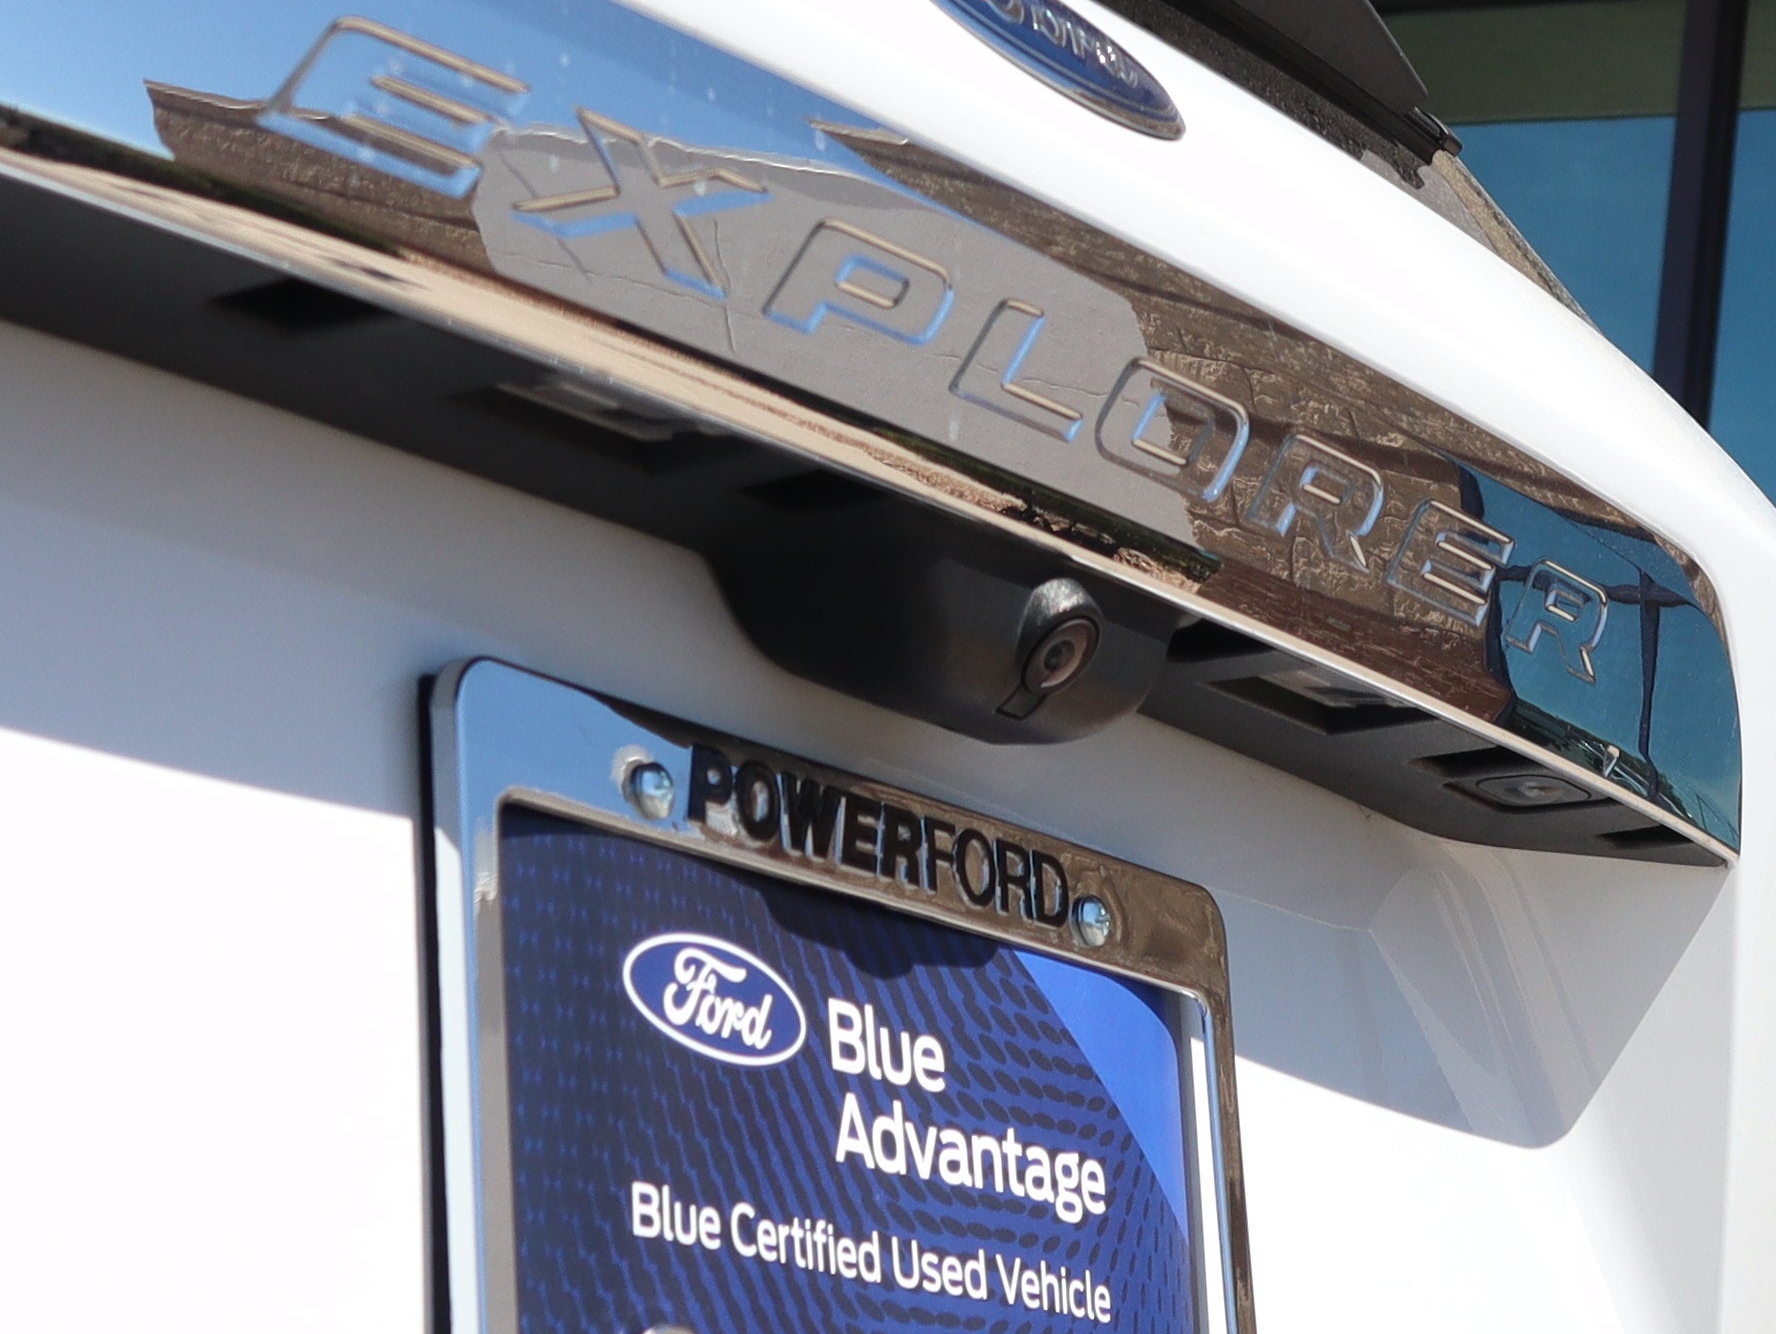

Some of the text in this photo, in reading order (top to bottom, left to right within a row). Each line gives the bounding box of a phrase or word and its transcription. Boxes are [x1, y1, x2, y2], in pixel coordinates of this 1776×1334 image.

[255, 15, 1610, 684] EXPLORER
[662, 947, 773, 1050] Ford
[827, 997, 946, 1092] Blue
[835, 1092, 1106, 1223] Advantage
[630, 1180, 1112, 1323] Blue Certified Used Vehicle
